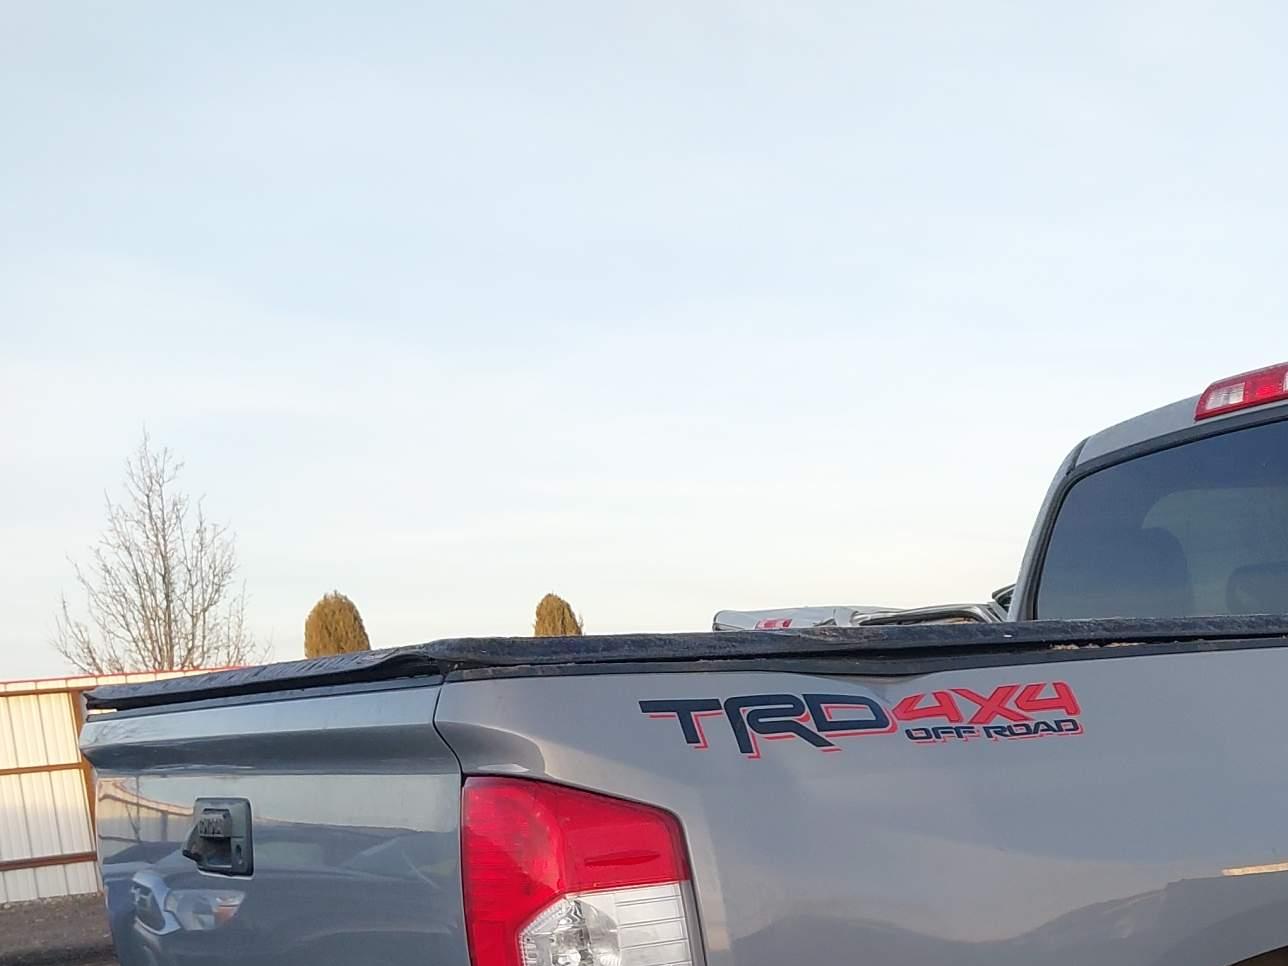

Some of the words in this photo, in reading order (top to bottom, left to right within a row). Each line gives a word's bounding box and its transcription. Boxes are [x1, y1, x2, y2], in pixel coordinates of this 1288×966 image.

[638, 693, 898, 760] TRD
[904, 724, 983, 744] OFF
[983, 718, 1084, 742] ROAD
